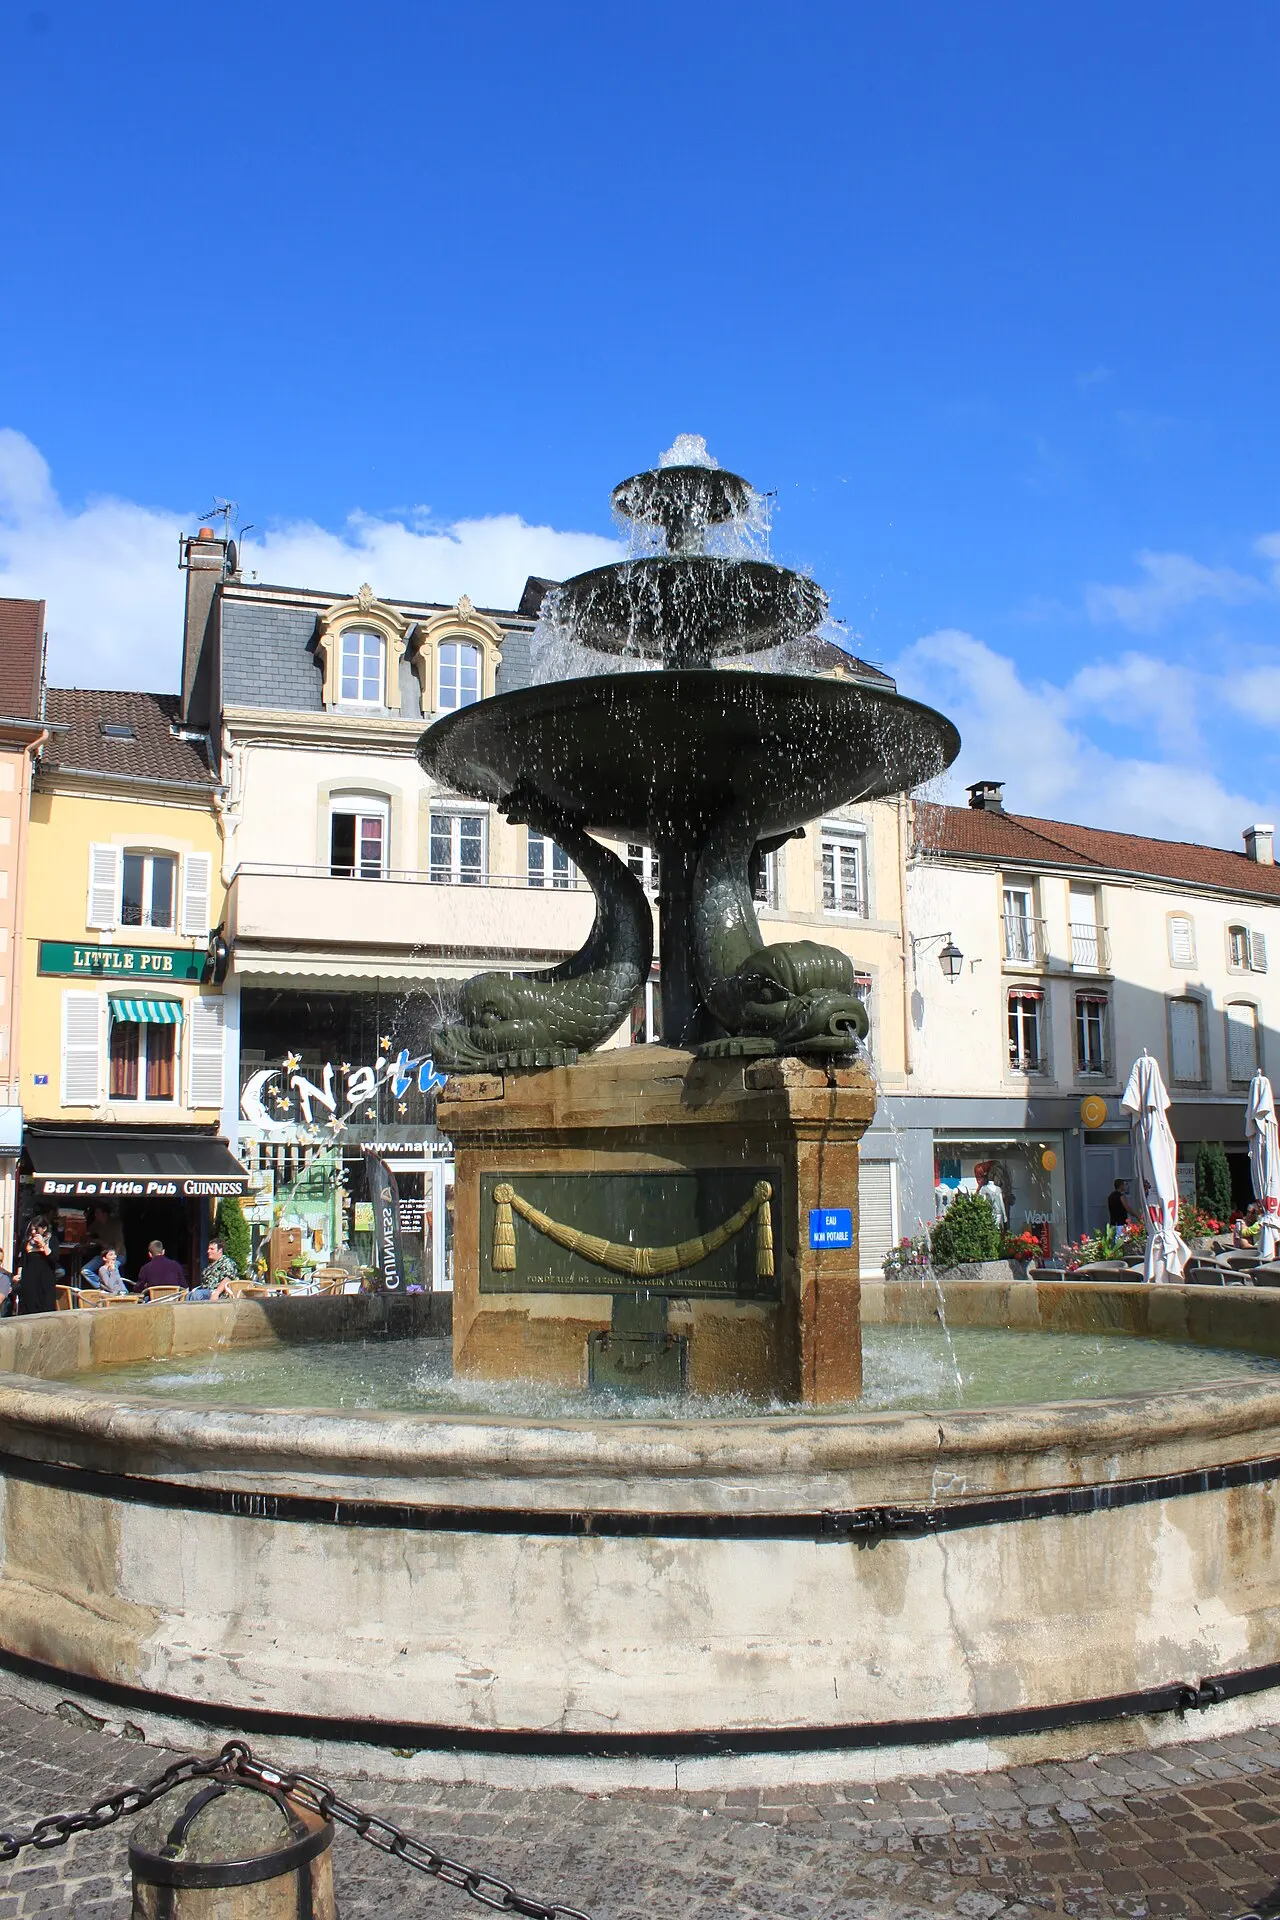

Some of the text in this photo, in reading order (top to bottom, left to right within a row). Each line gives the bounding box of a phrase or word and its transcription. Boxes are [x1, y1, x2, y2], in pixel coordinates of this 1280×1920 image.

[73, 950, 173, 971] LITTLE PUB
[38, 1075, 45, 1084] 7
[1085, 1102, 1099, 1121] C
[43, 1180, 242, 1195] Bar Le Little Pub GUINNESS
[825, 1216, 837, 1226] EAU
[813, 1231, 849, 1242] NON POTABLE
